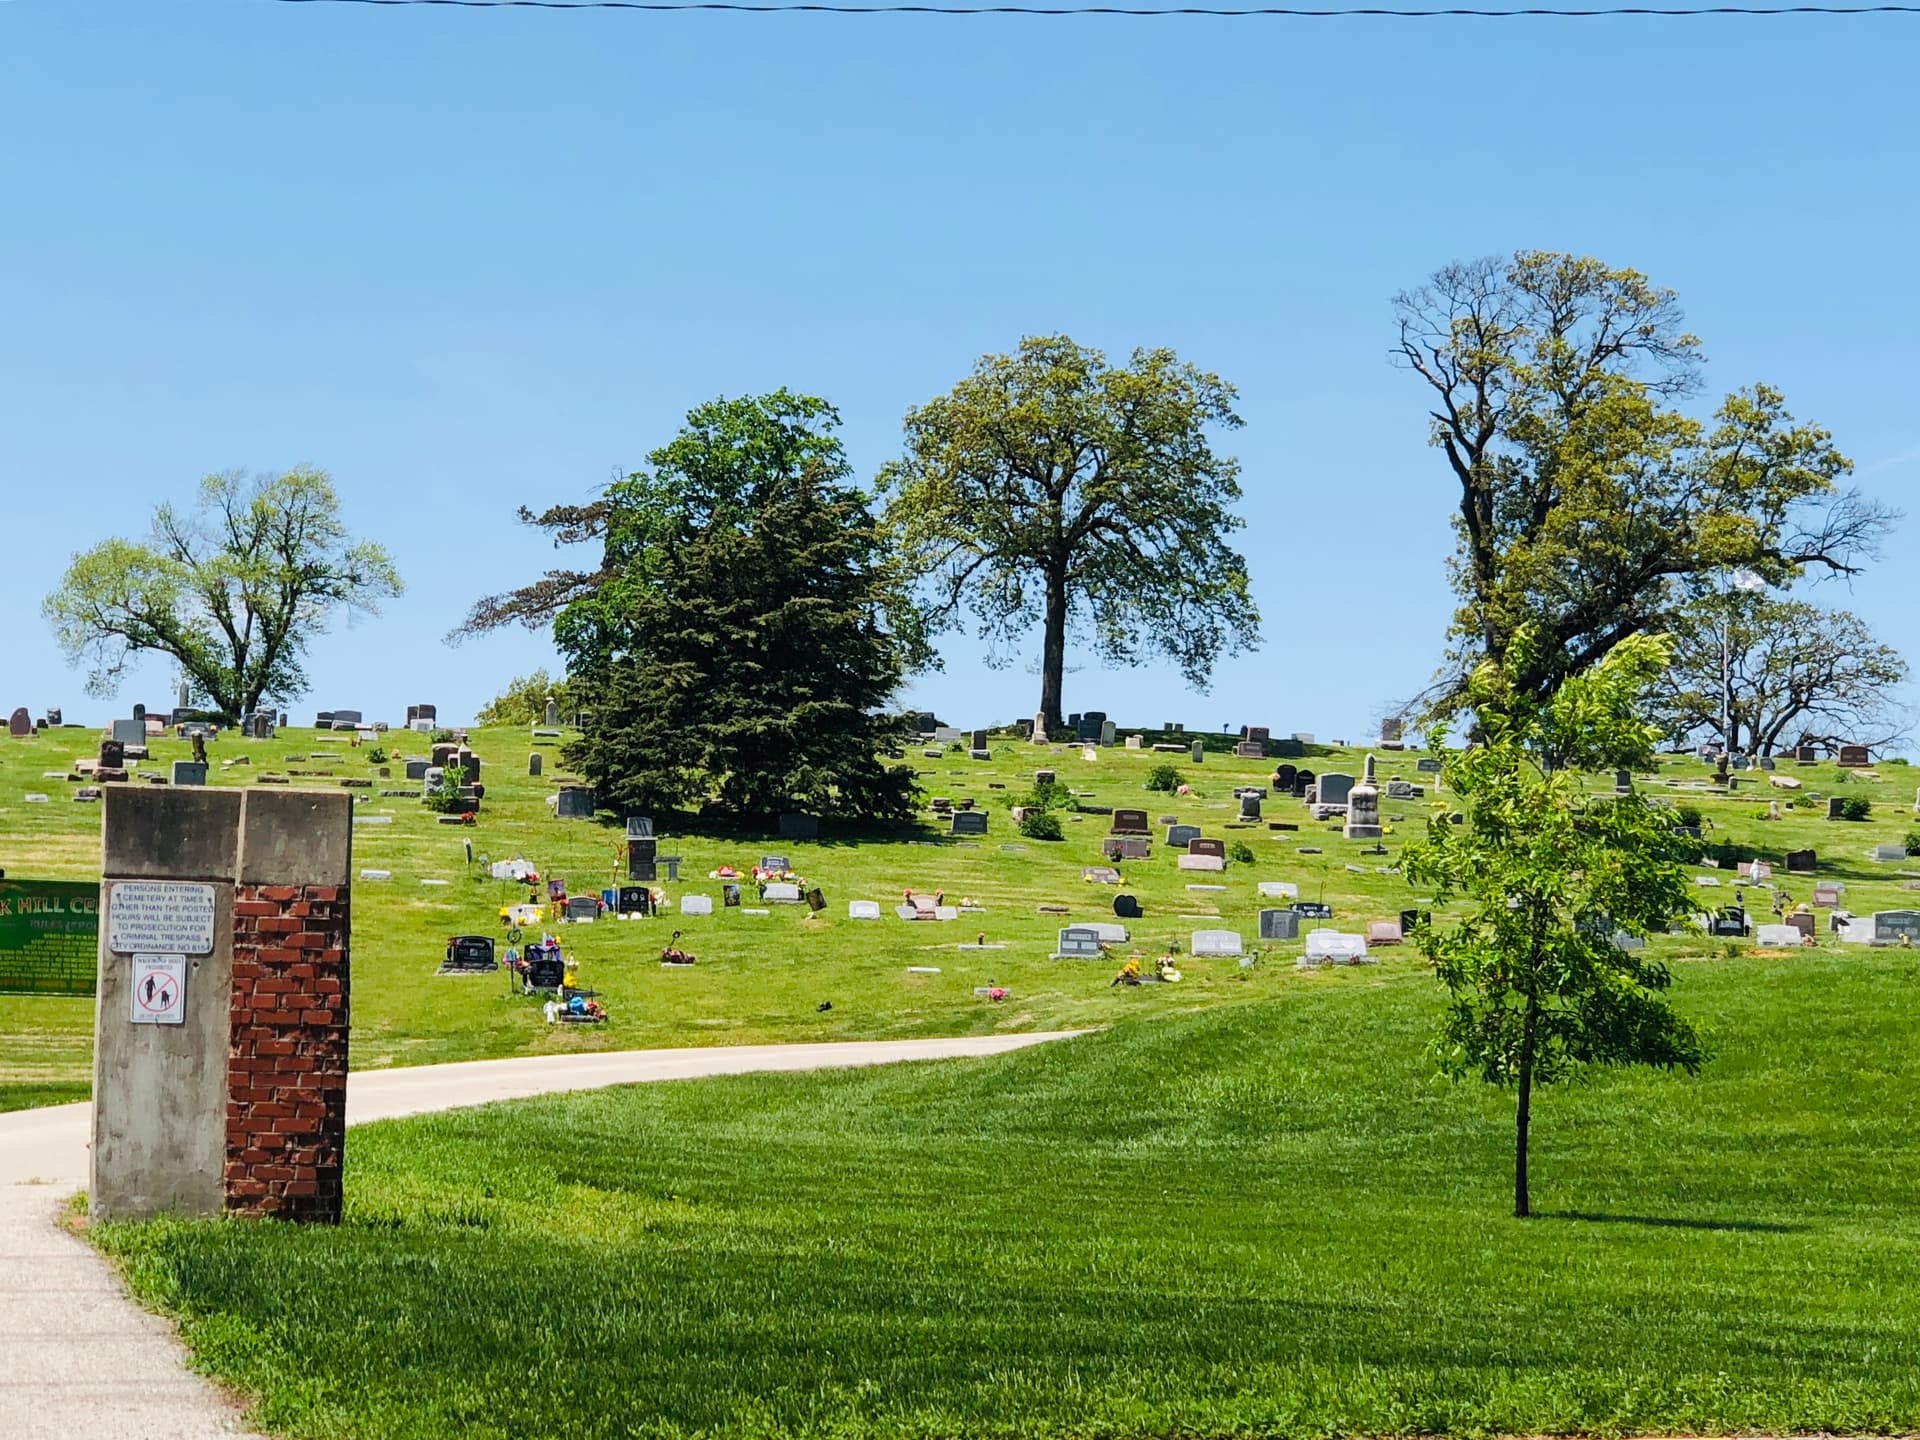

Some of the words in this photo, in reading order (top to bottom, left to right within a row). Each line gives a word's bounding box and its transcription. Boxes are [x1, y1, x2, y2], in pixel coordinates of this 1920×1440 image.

[122, 894, 166, 902] CEMETERY
[18, 896, 64, 914] HILL
[112, 904, 138, 912] OTHER
[142, 904, 162, 912] THAN
[182, 905, 214, 913] POSTED
[130, 924, 188, 932] PROSECUTION
[160, 934, 200, 942] TRESPASS
